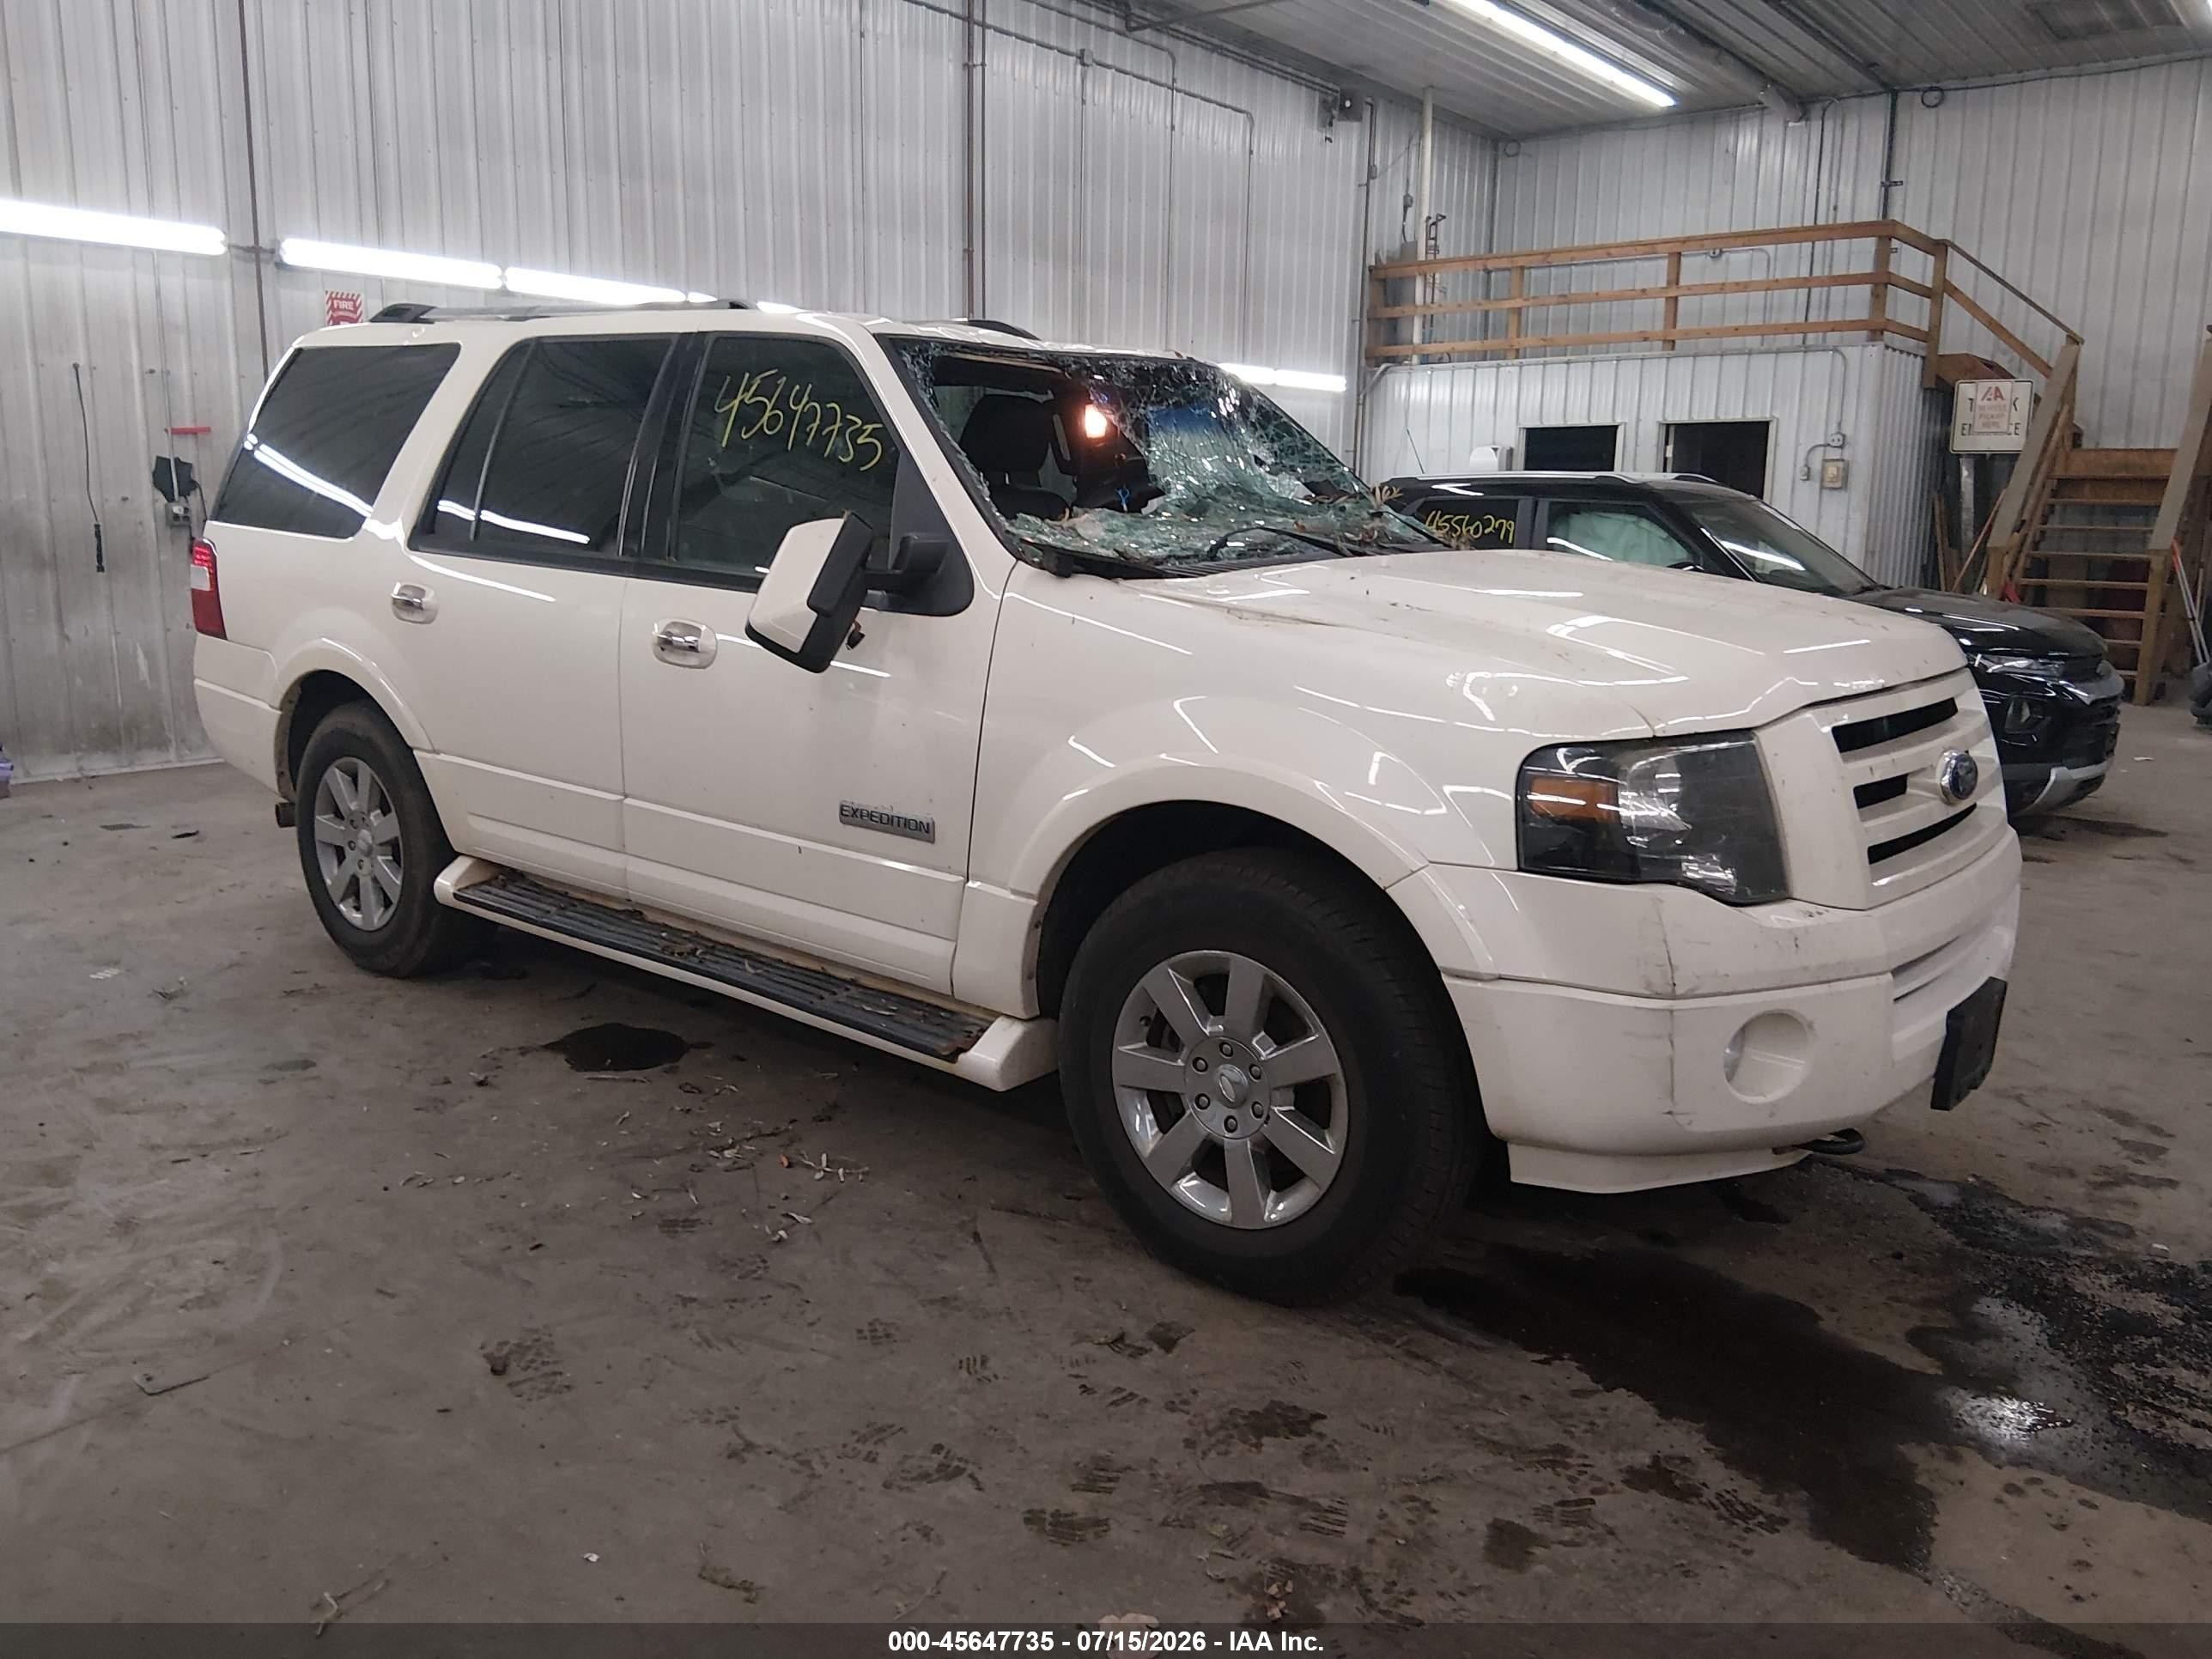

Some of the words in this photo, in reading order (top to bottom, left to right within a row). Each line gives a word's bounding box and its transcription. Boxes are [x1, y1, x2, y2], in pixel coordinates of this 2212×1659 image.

[333, 300, 356, 310] FIRE
[714, 368, 884, 471] 45647735
[1425, 509, 1515, 544] 45560279
[841, 804, 930, 834] EXPEDITION
